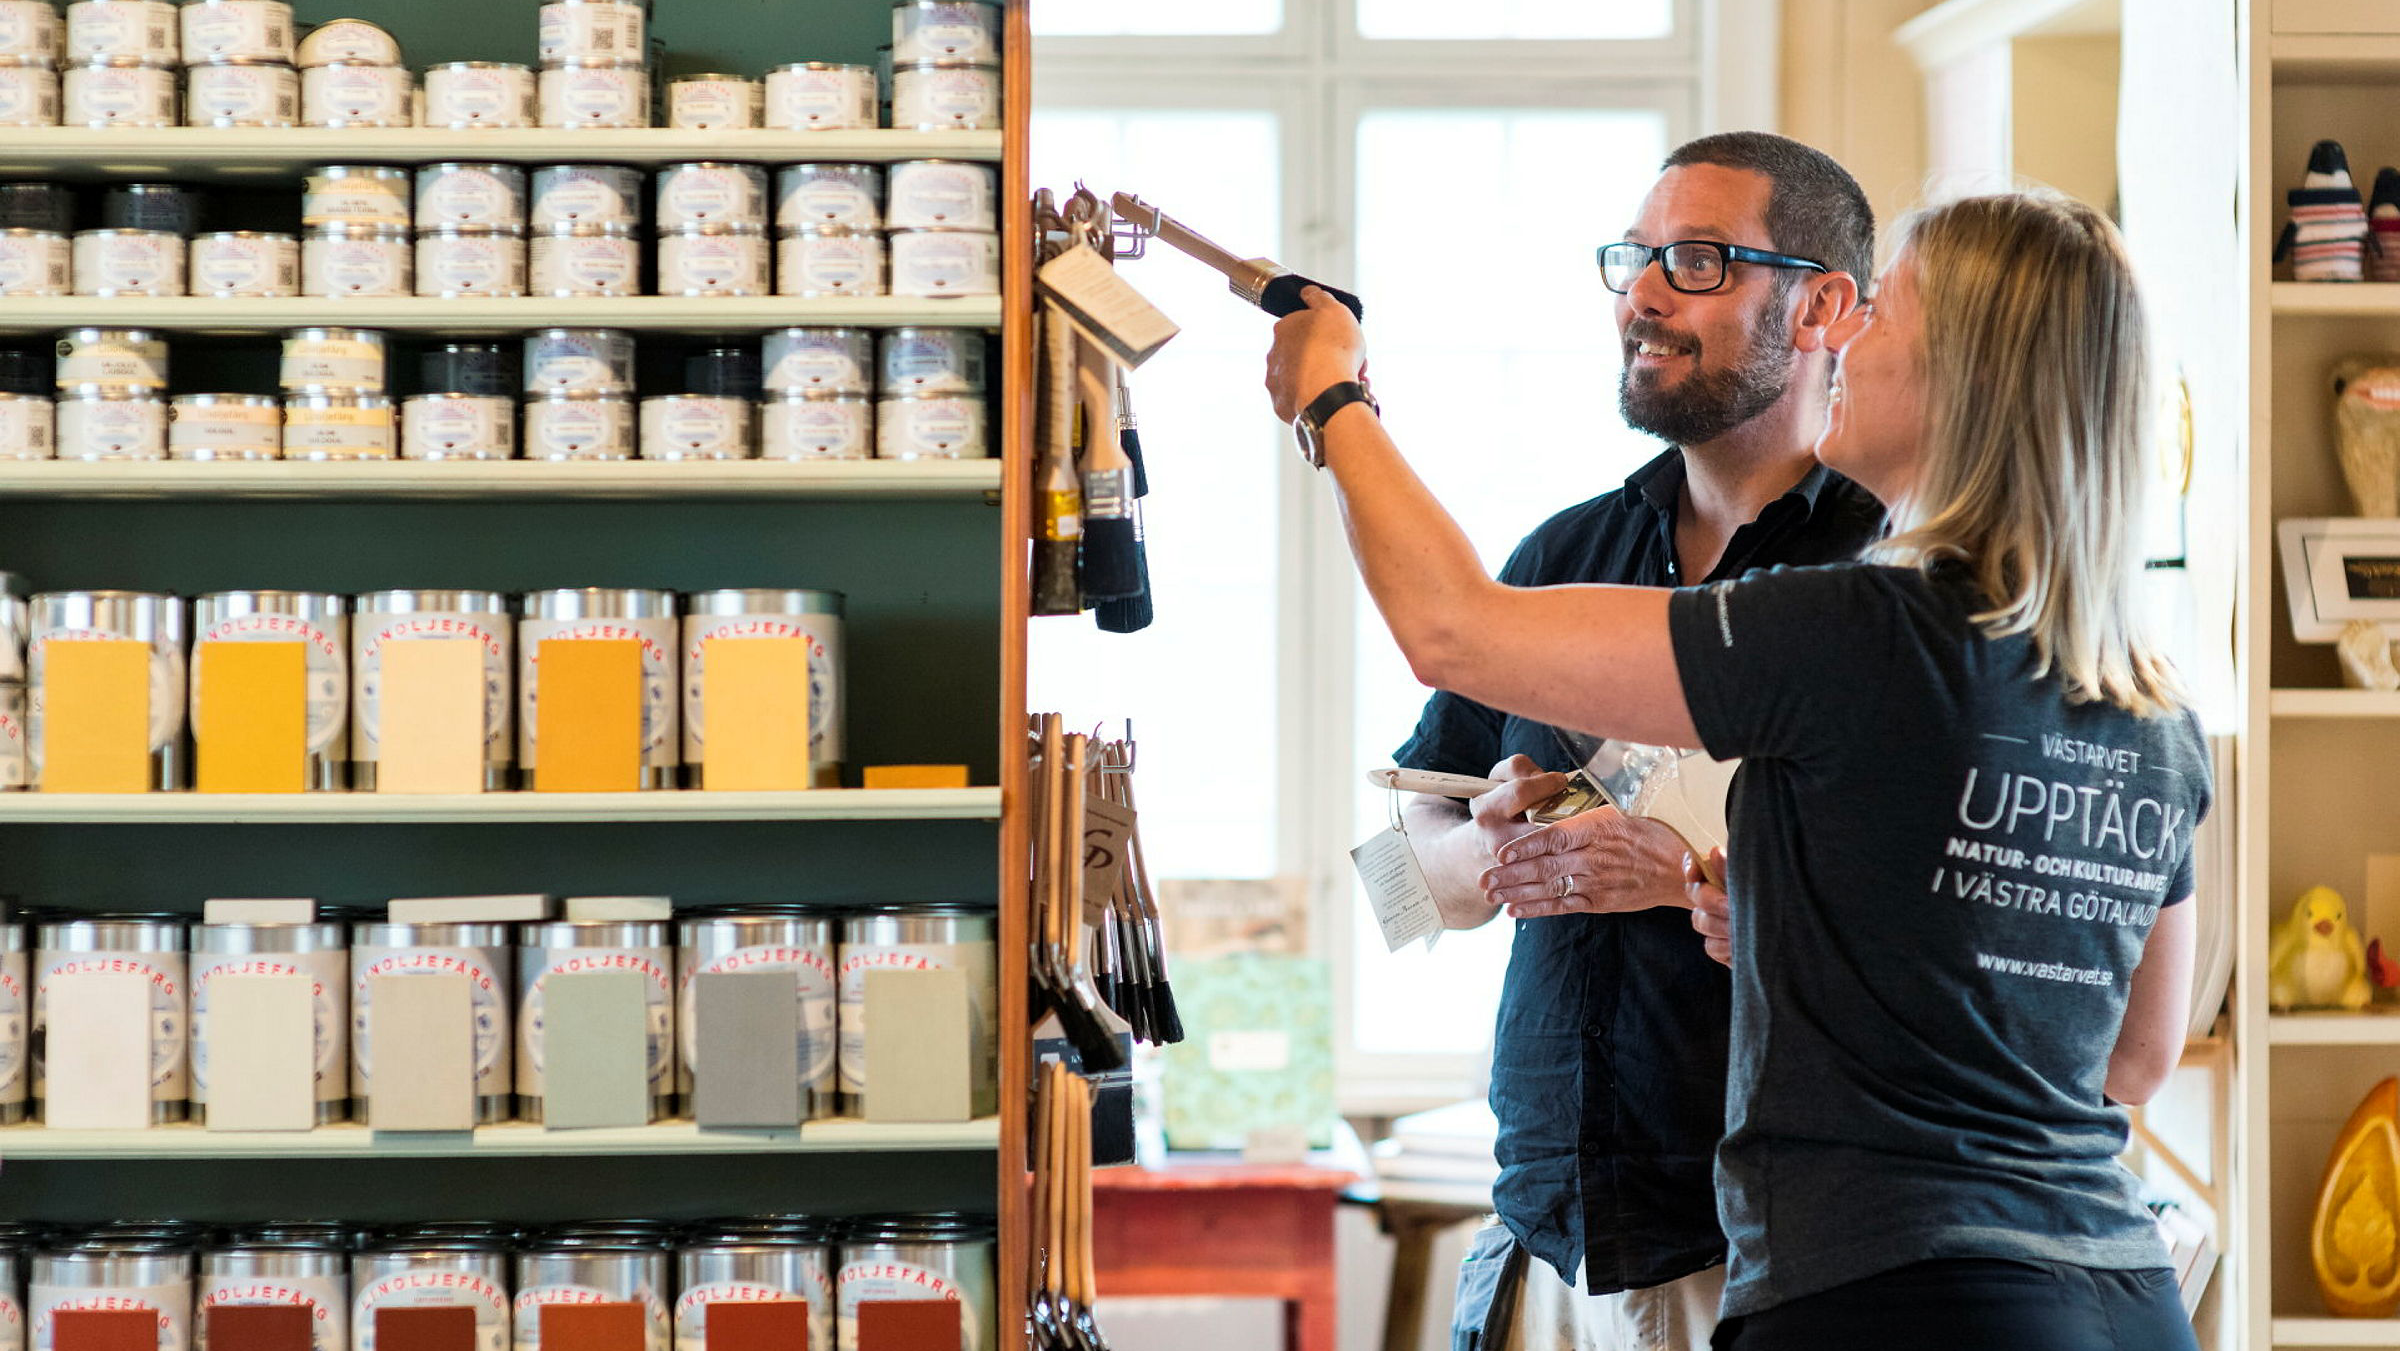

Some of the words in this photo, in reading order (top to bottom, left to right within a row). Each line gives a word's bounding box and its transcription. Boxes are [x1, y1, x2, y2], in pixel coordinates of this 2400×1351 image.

[2040, 732, 2141, 774] VÄSTARVET
[1957, 767, 2185, 863] UPPTÄCK
[1946, 836, 2031, 869] NATUR-
[2033, 854, 2072, 878] OCH
[2071, 859, 2168, 893] KULTURARVE
[1931, 866, 1945, 893] I
[1954, 870, 2061, 917] VÄSTRA
[1977, 951, 2114, 987] www.vastarvet.se
